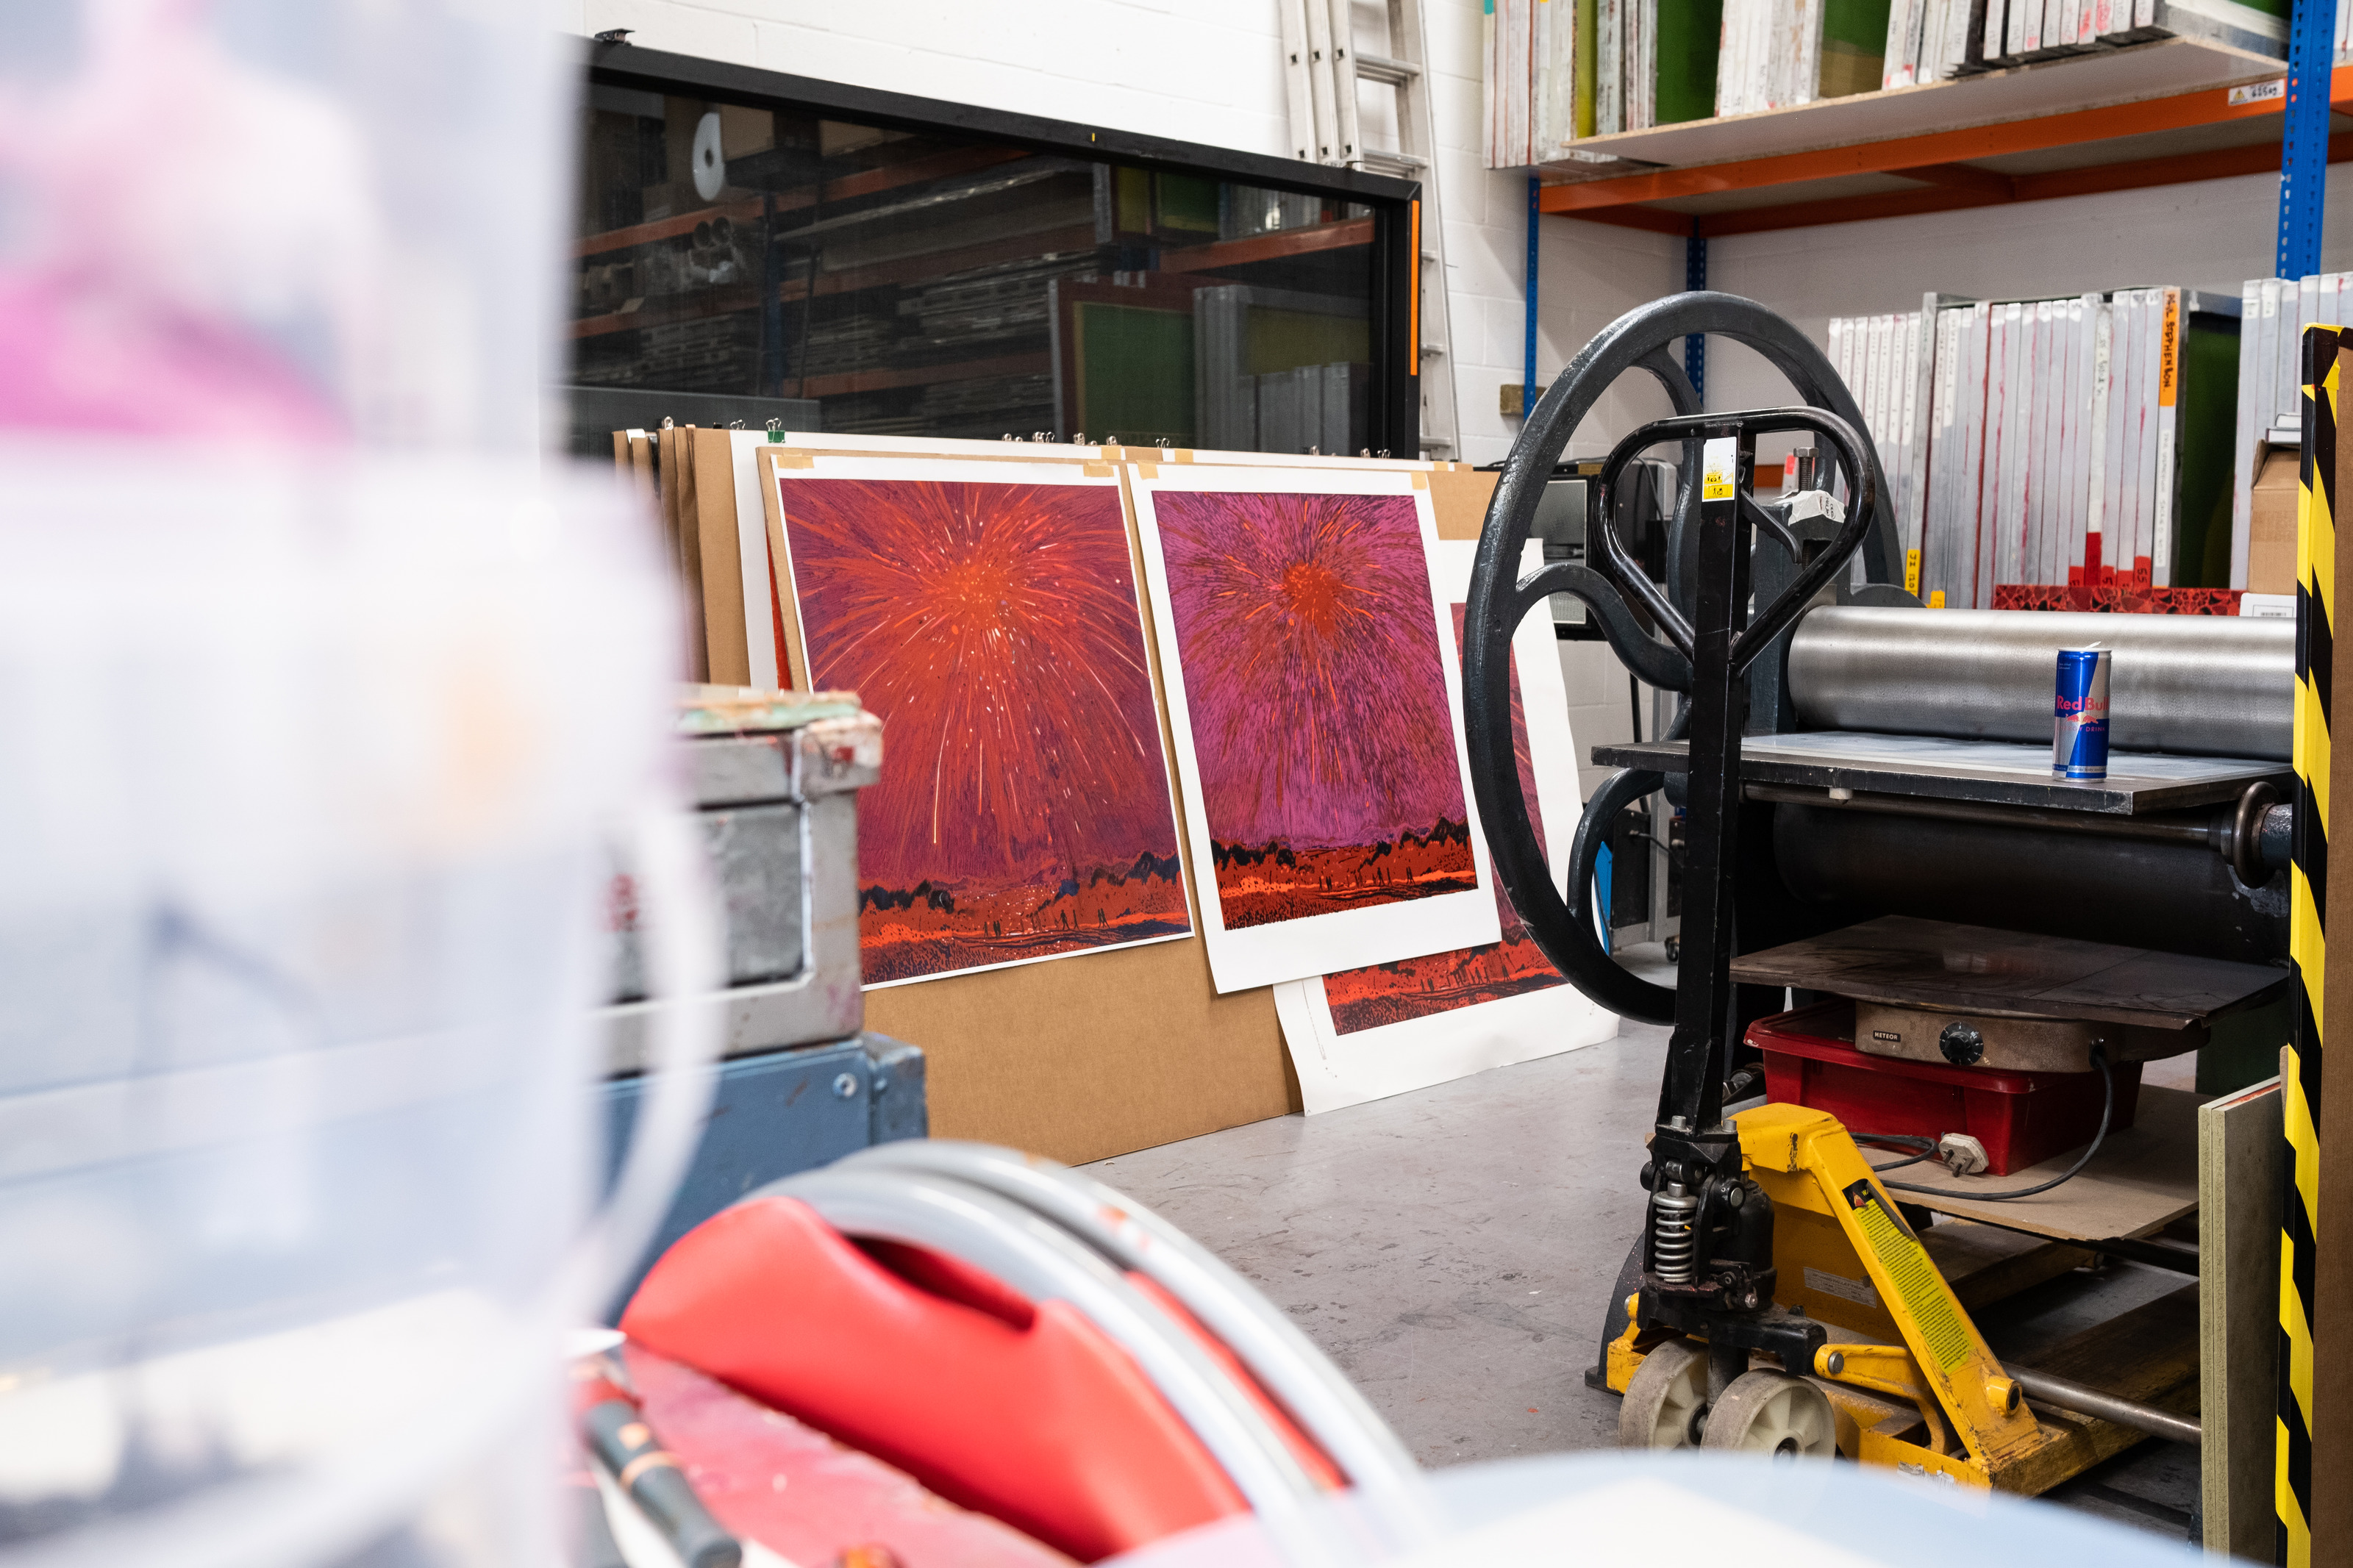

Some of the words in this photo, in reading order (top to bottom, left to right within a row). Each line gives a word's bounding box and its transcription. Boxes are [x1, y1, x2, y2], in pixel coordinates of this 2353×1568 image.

[2057, 695, 2082, 711] Red
[2085, 696, 2110, 711] Bull
[1874, 1031, 1898, 1041] METEOR
